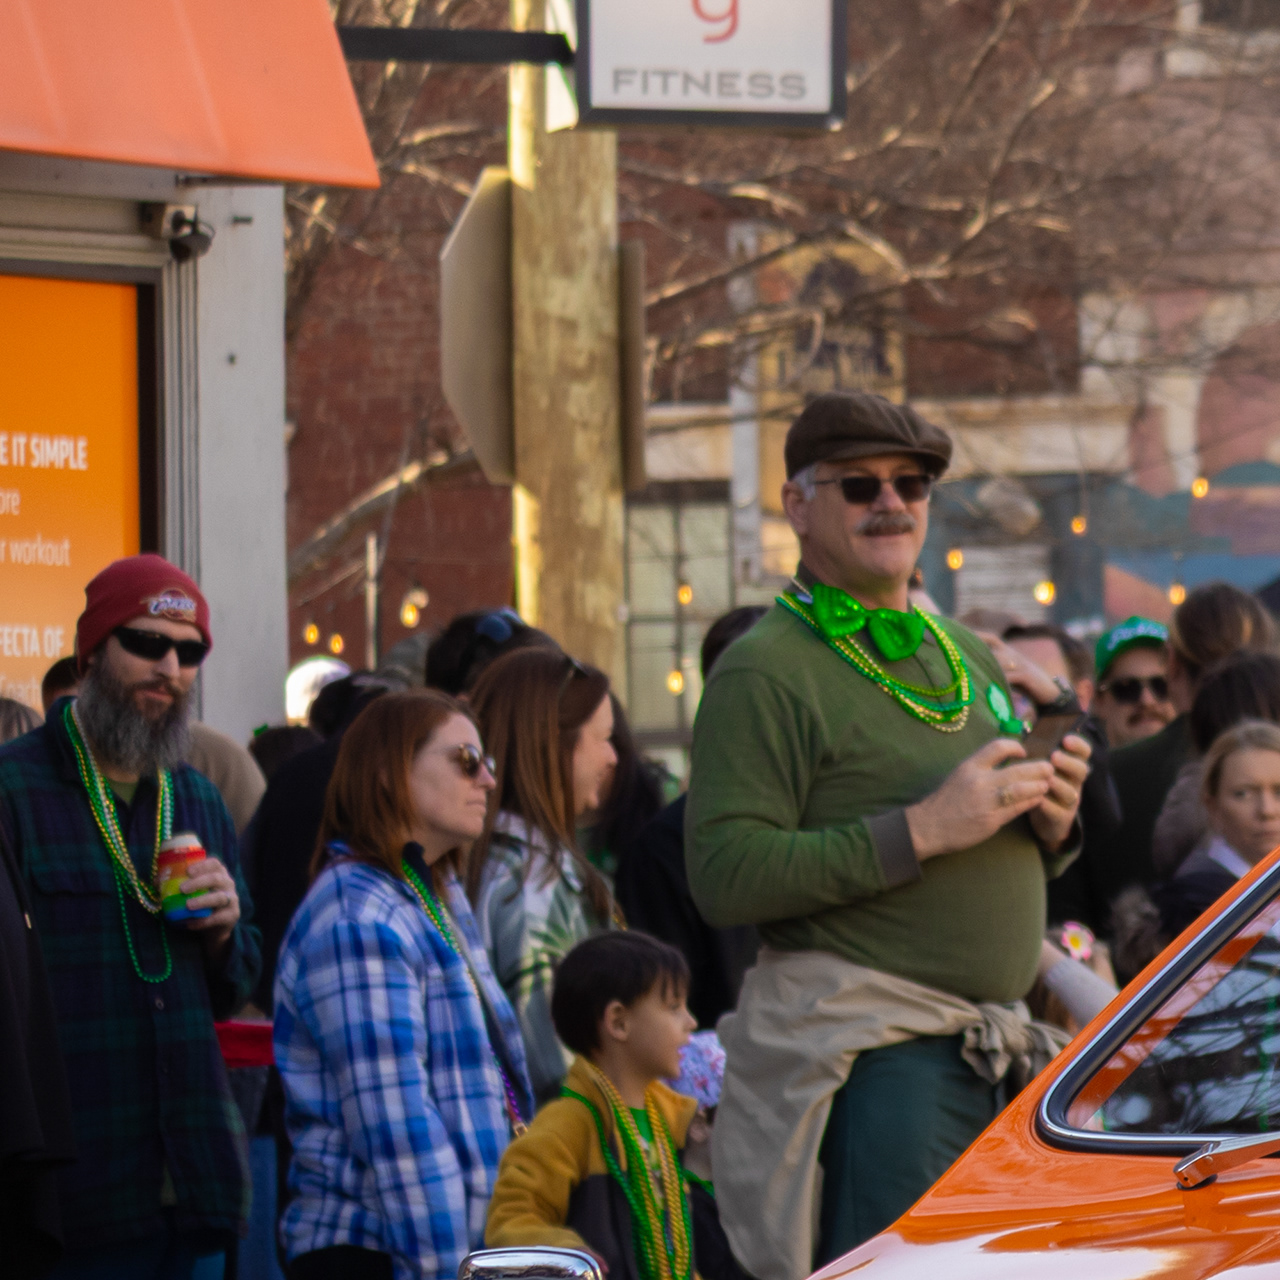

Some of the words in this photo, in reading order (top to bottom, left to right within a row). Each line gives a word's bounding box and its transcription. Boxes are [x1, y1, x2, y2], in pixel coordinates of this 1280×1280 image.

[612, 68, 808, 100] FITNESS
[12, 432, 26, 467] IT
[30, 434, 88, 471] SIMPLE
[10, 532, 70, 568] workout
[44, 626, 64, 658] OF
